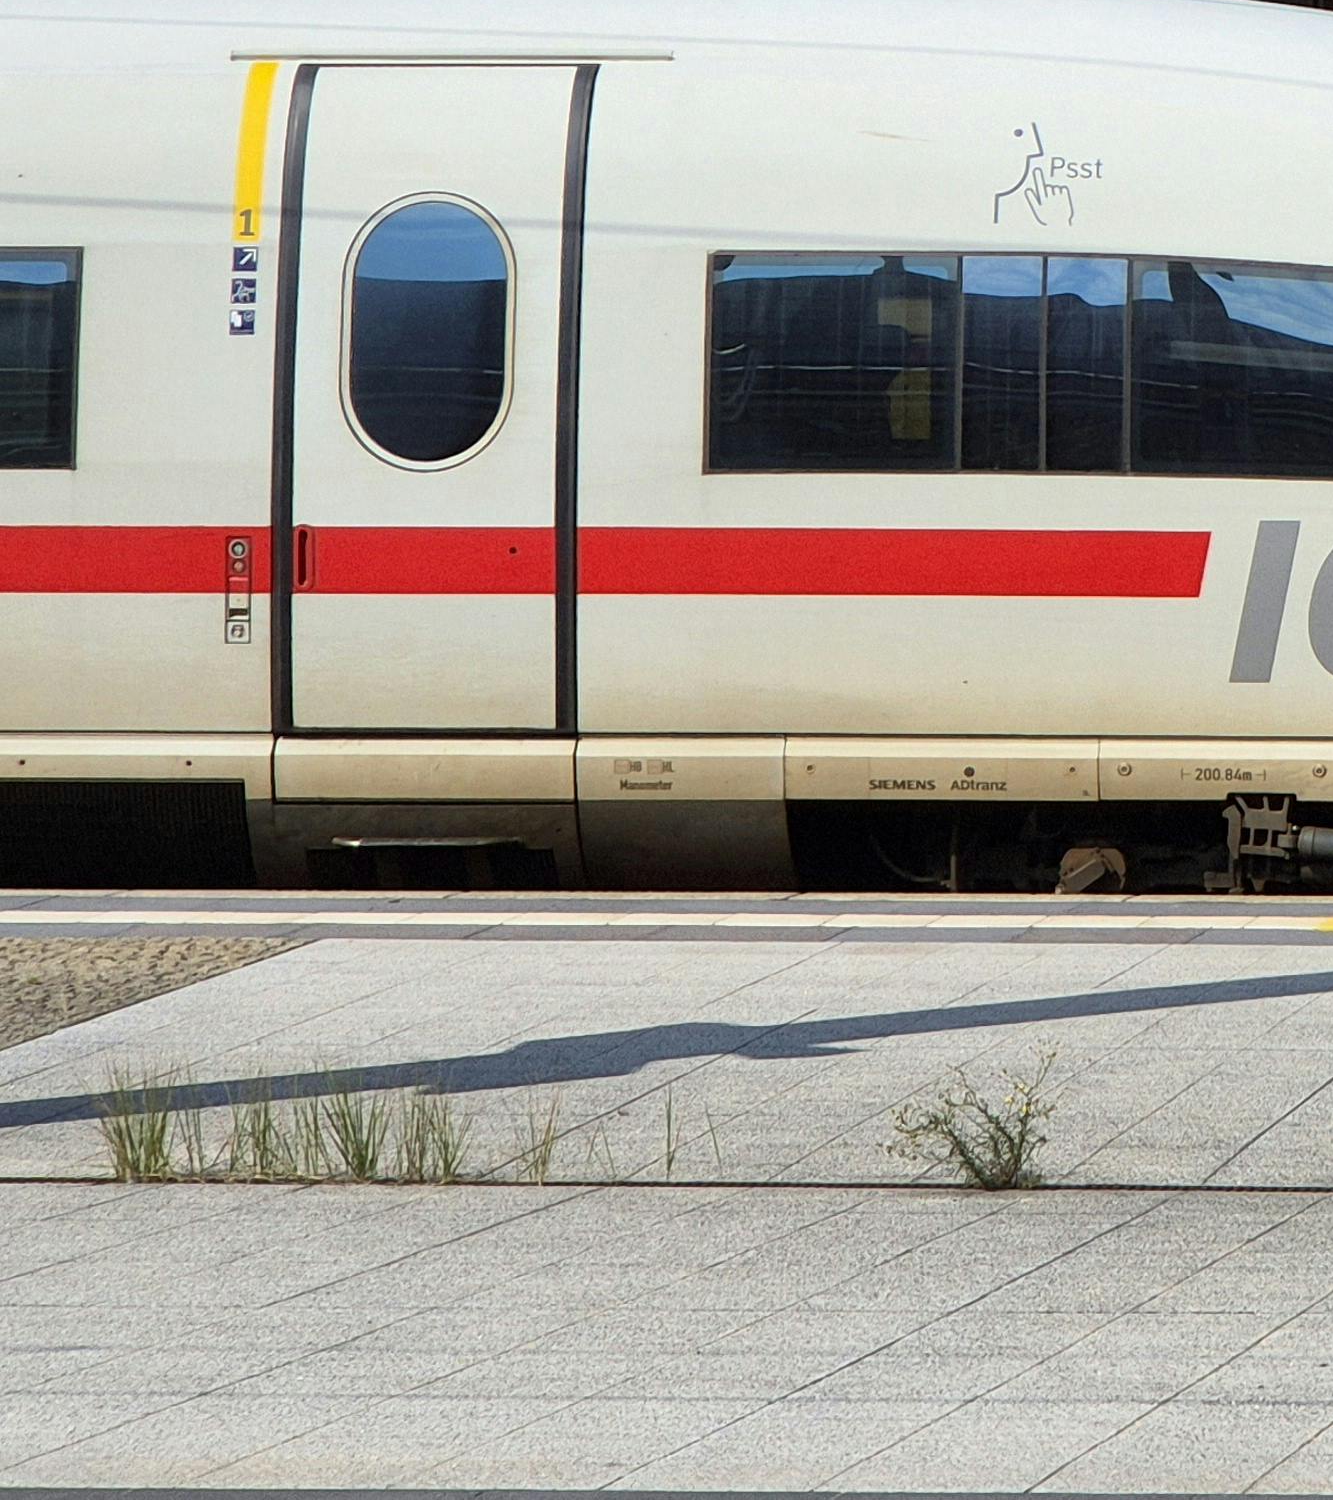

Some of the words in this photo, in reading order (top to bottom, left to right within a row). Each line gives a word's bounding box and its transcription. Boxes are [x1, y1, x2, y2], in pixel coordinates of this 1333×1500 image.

[1050, 156, 1103, 179] Psst
[239, 209, 255, 236] 1
[1195, 768, 1253, 781] 200.84m
[869, 779, 936, 790] SIEMENS
[951, 779, 1007, 791] ADtranz
